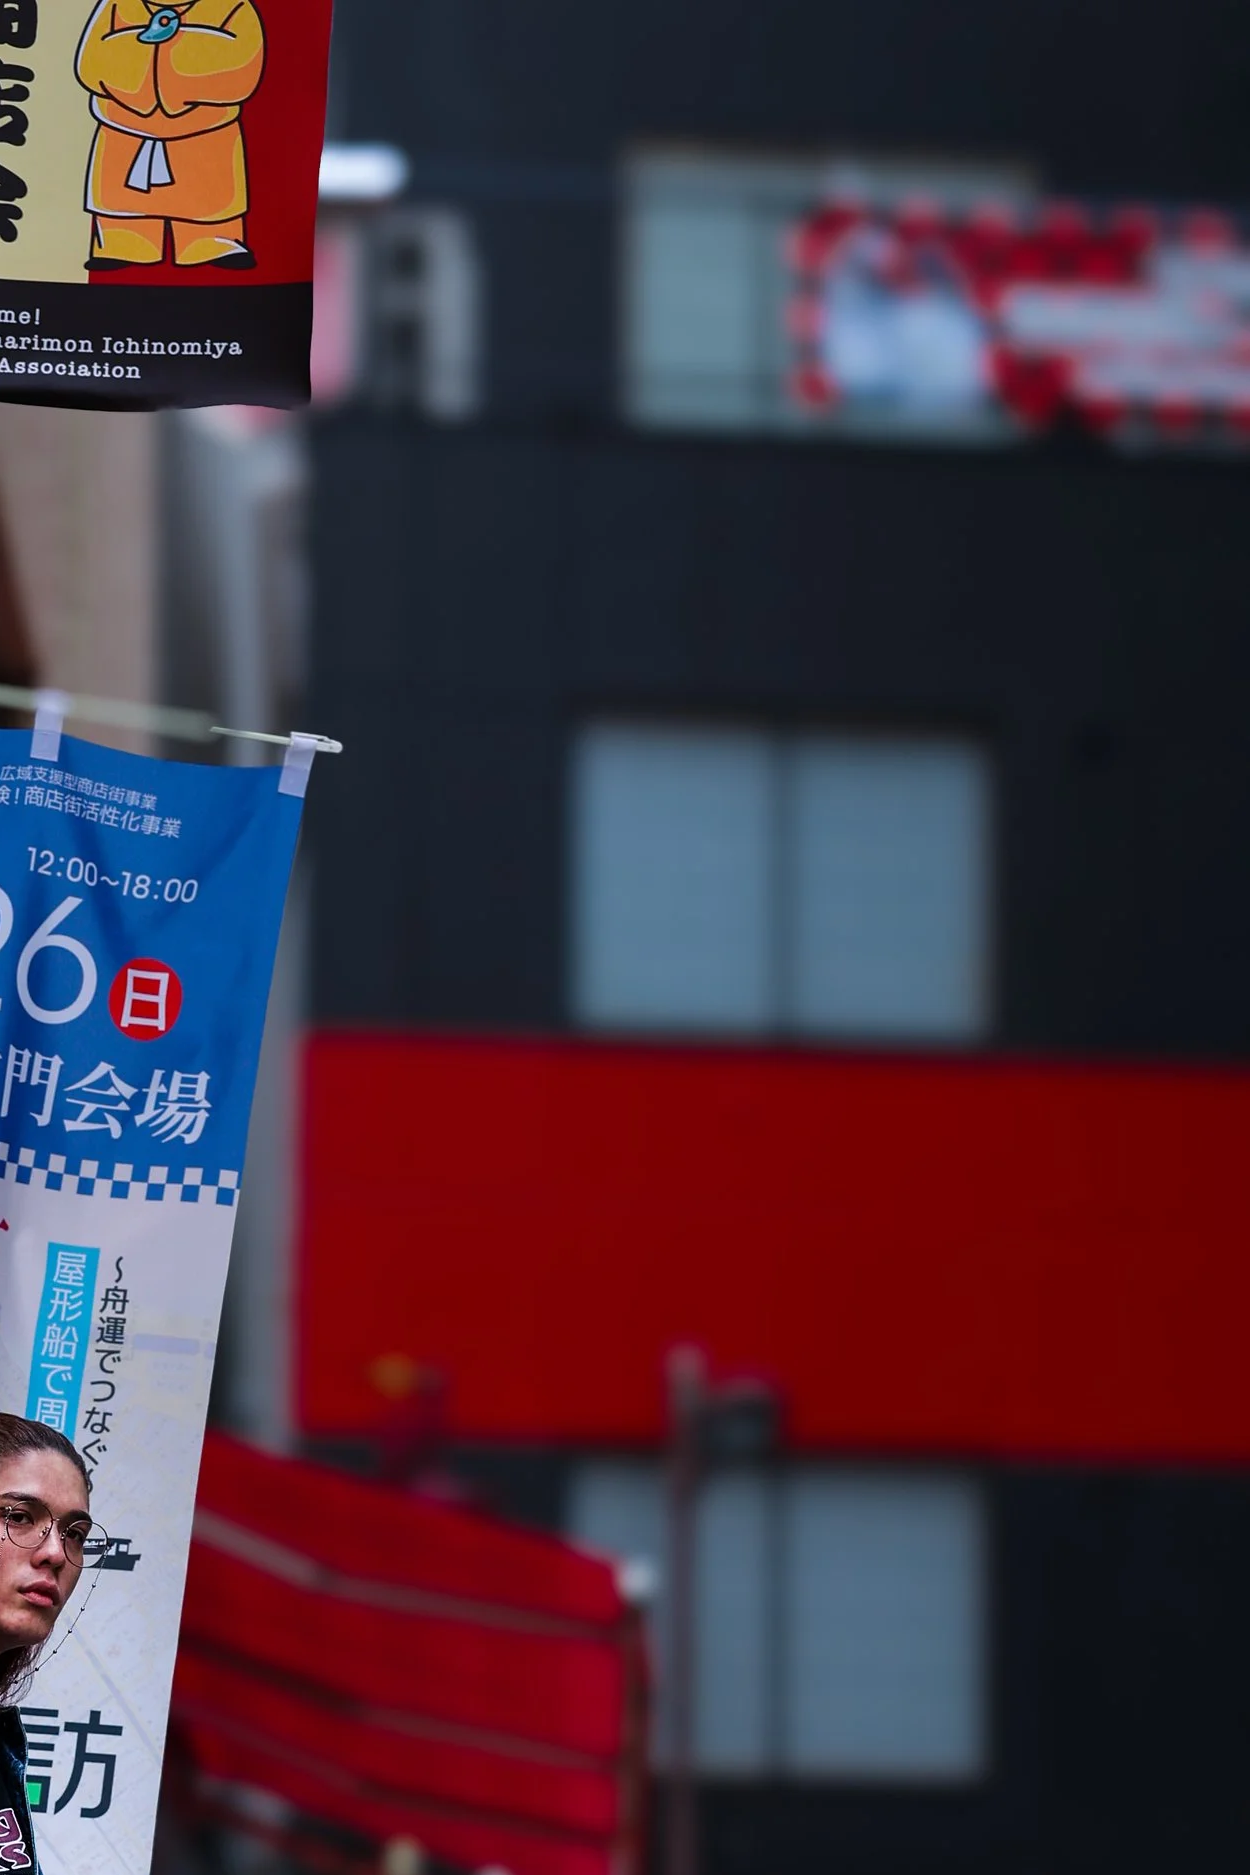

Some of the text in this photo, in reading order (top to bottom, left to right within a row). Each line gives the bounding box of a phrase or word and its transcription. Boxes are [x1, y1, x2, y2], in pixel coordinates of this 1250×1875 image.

[102, 336, 243, 359] Ichinomiya
[0, 764, 158, 812] 広域支援型商店街事業
[120, 967, 170, 1032] 日
